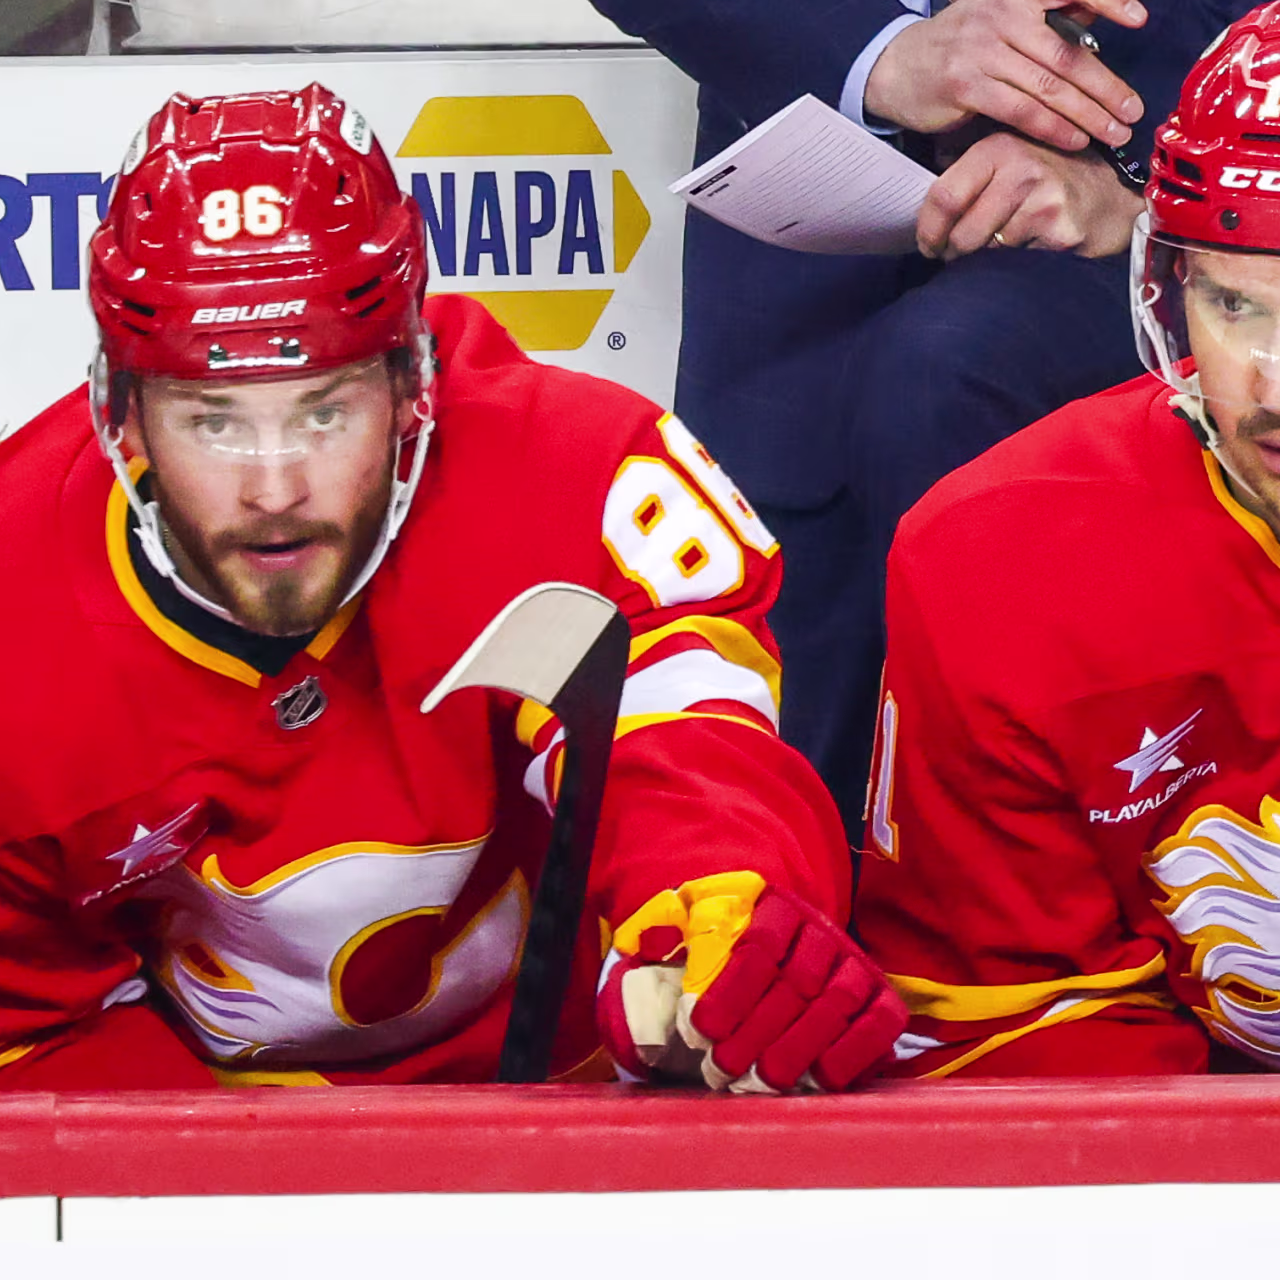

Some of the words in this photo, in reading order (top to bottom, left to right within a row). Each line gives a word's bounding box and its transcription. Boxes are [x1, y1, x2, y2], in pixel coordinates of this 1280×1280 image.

[203, 185, 282, 242] 86
[412, 170, 605, 276] NAPA
[191, 299, 307, 324] BAUER
[1089, 761, 1217, 823] PLAYALBERTA
